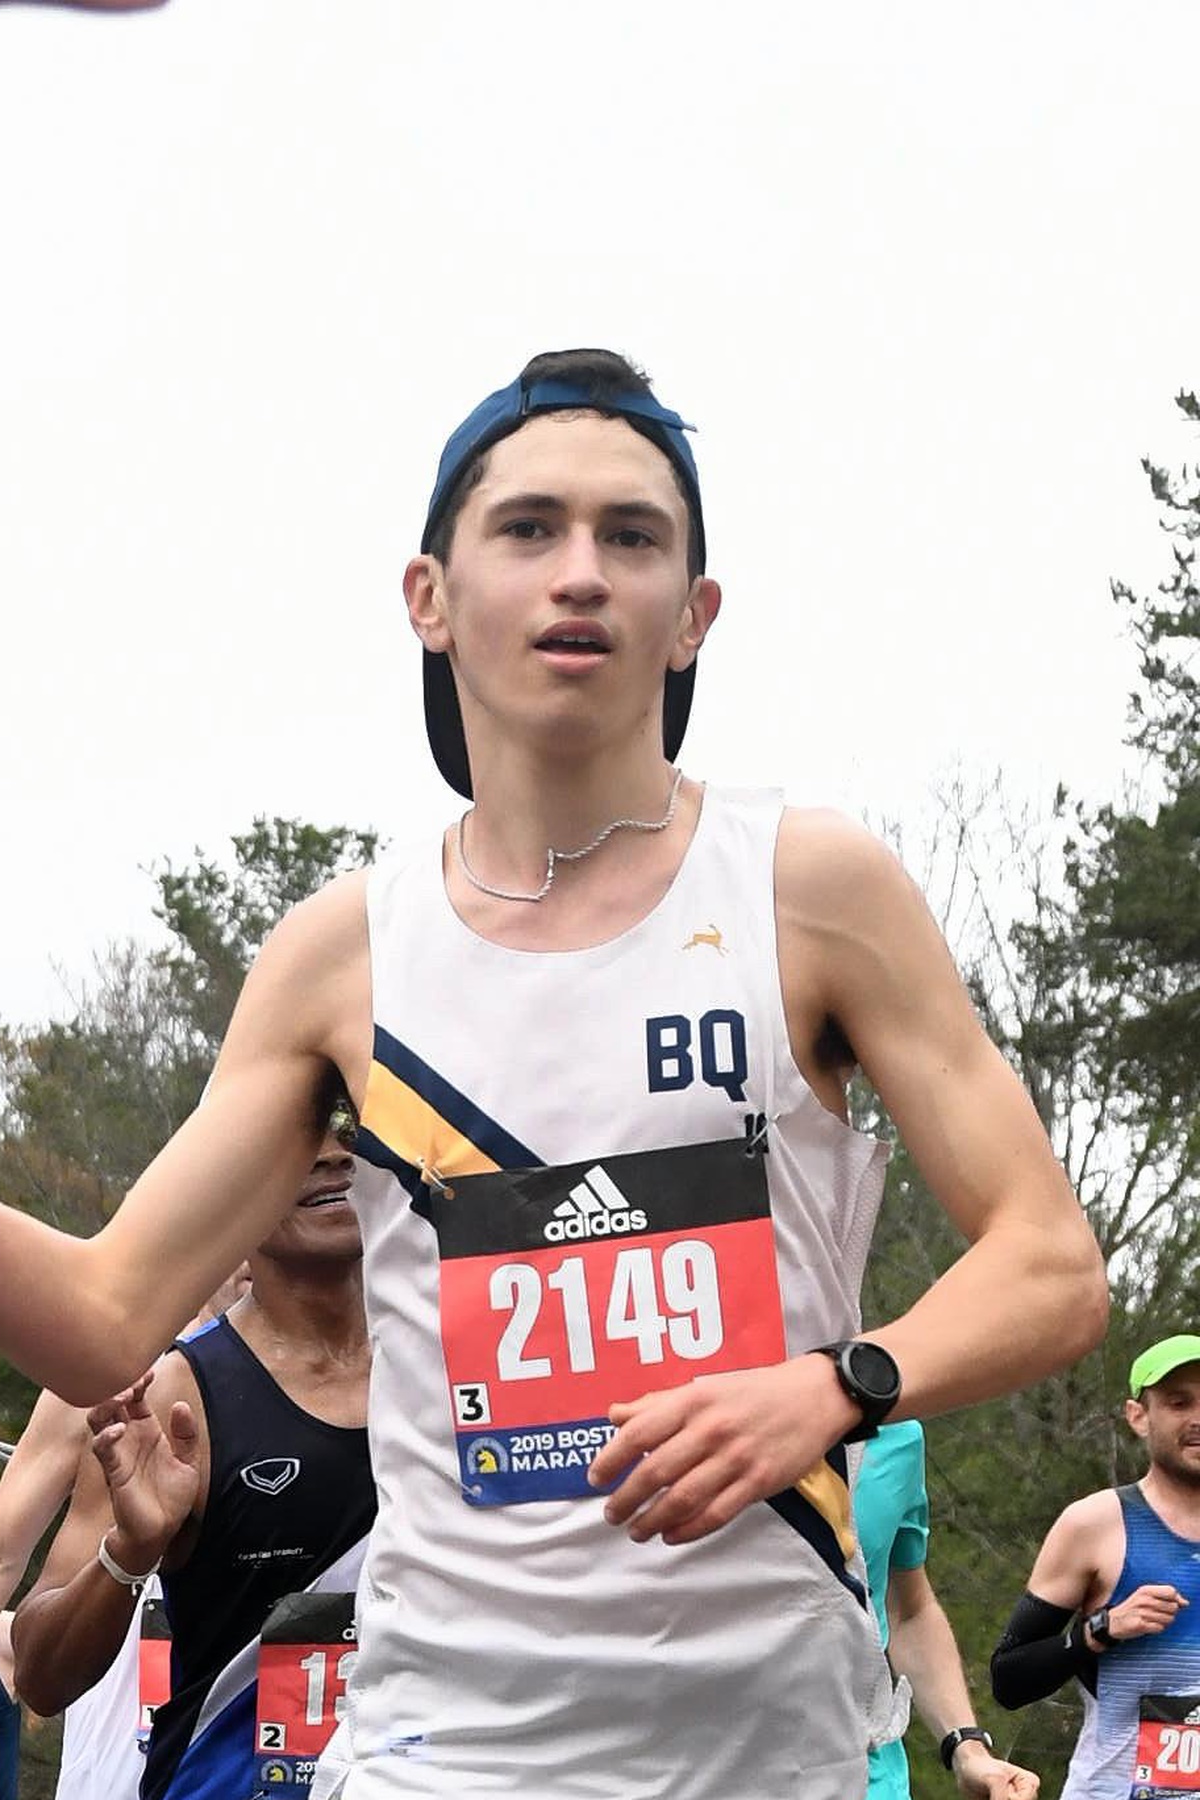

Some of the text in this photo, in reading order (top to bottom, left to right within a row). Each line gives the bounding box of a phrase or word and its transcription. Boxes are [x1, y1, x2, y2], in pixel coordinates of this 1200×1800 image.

[645, 1008, 748, 1103] BQ
[544, 1206, 648, 1244] adidas
[488, 1239, 725, 1382] 2149
[458, 1387, 484, 1422] 3
[509, 1424, 620, 1454] 2019 BOST
[511, 1446, 601, 1473] MARAT
[262, 1726, 281, 1749] 2
